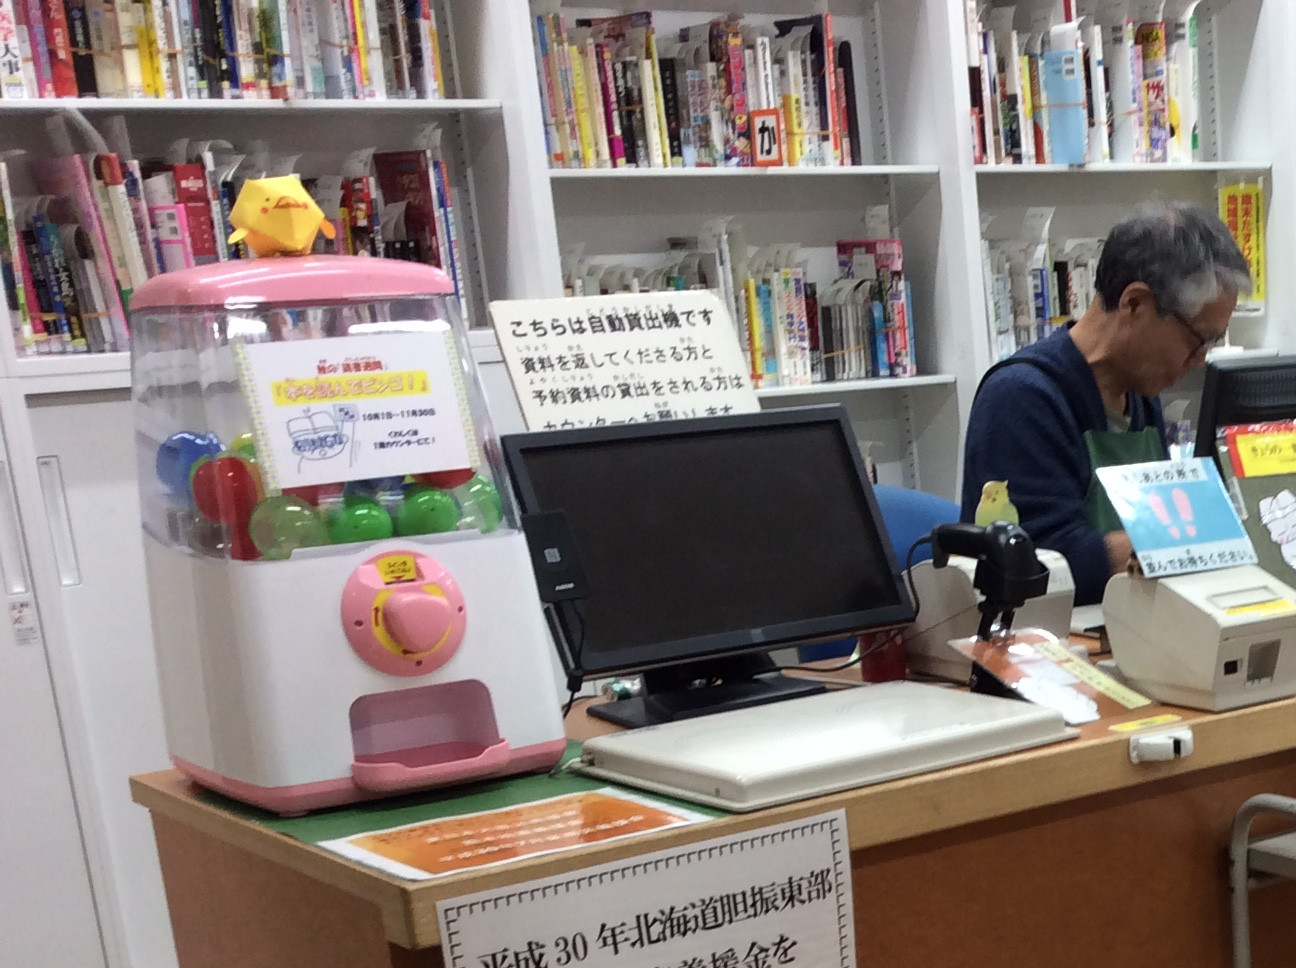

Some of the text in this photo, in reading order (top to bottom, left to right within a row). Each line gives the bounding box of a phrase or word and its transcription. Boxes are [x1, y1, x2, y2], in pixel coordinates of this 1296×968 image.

[758, 120, 777, 156] か
[510, 308, 714, 338] こちらは自動貸出機です
[520, 345, 714, 375] 資料を返してくださる方と
[531, 374, 745, 407] 予約資料の貸出をされる方は
